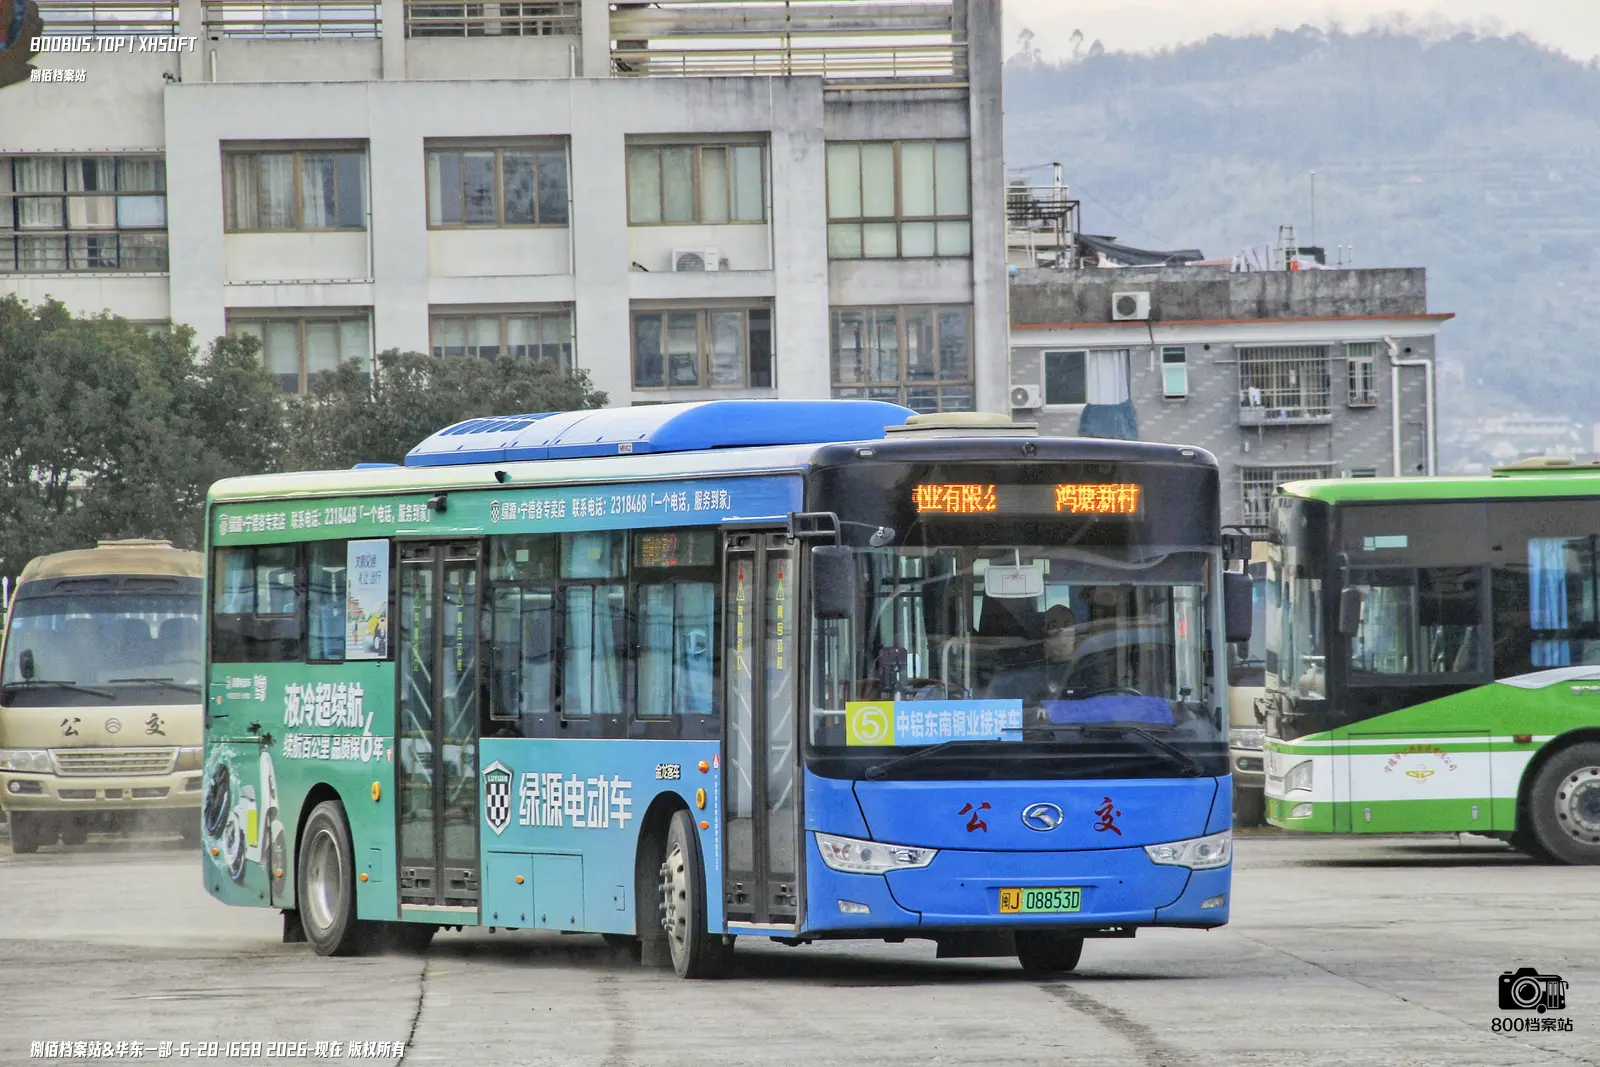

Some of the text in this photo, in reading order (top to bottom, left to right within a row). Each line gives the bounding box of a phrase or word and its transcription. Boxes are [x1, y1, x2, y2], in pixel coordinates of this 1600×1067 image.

[60, 713, 166, 737] 公 交
[284, 681, 364, 728] 液冷超续航
[282, 711, 384, 763] 续航百公里 品质保6年
[655, 764, 681, 780] 金龙客车
[519, 772, 632, 830] 绿源电动车
[958, 797, 1122, 836] 公 交
